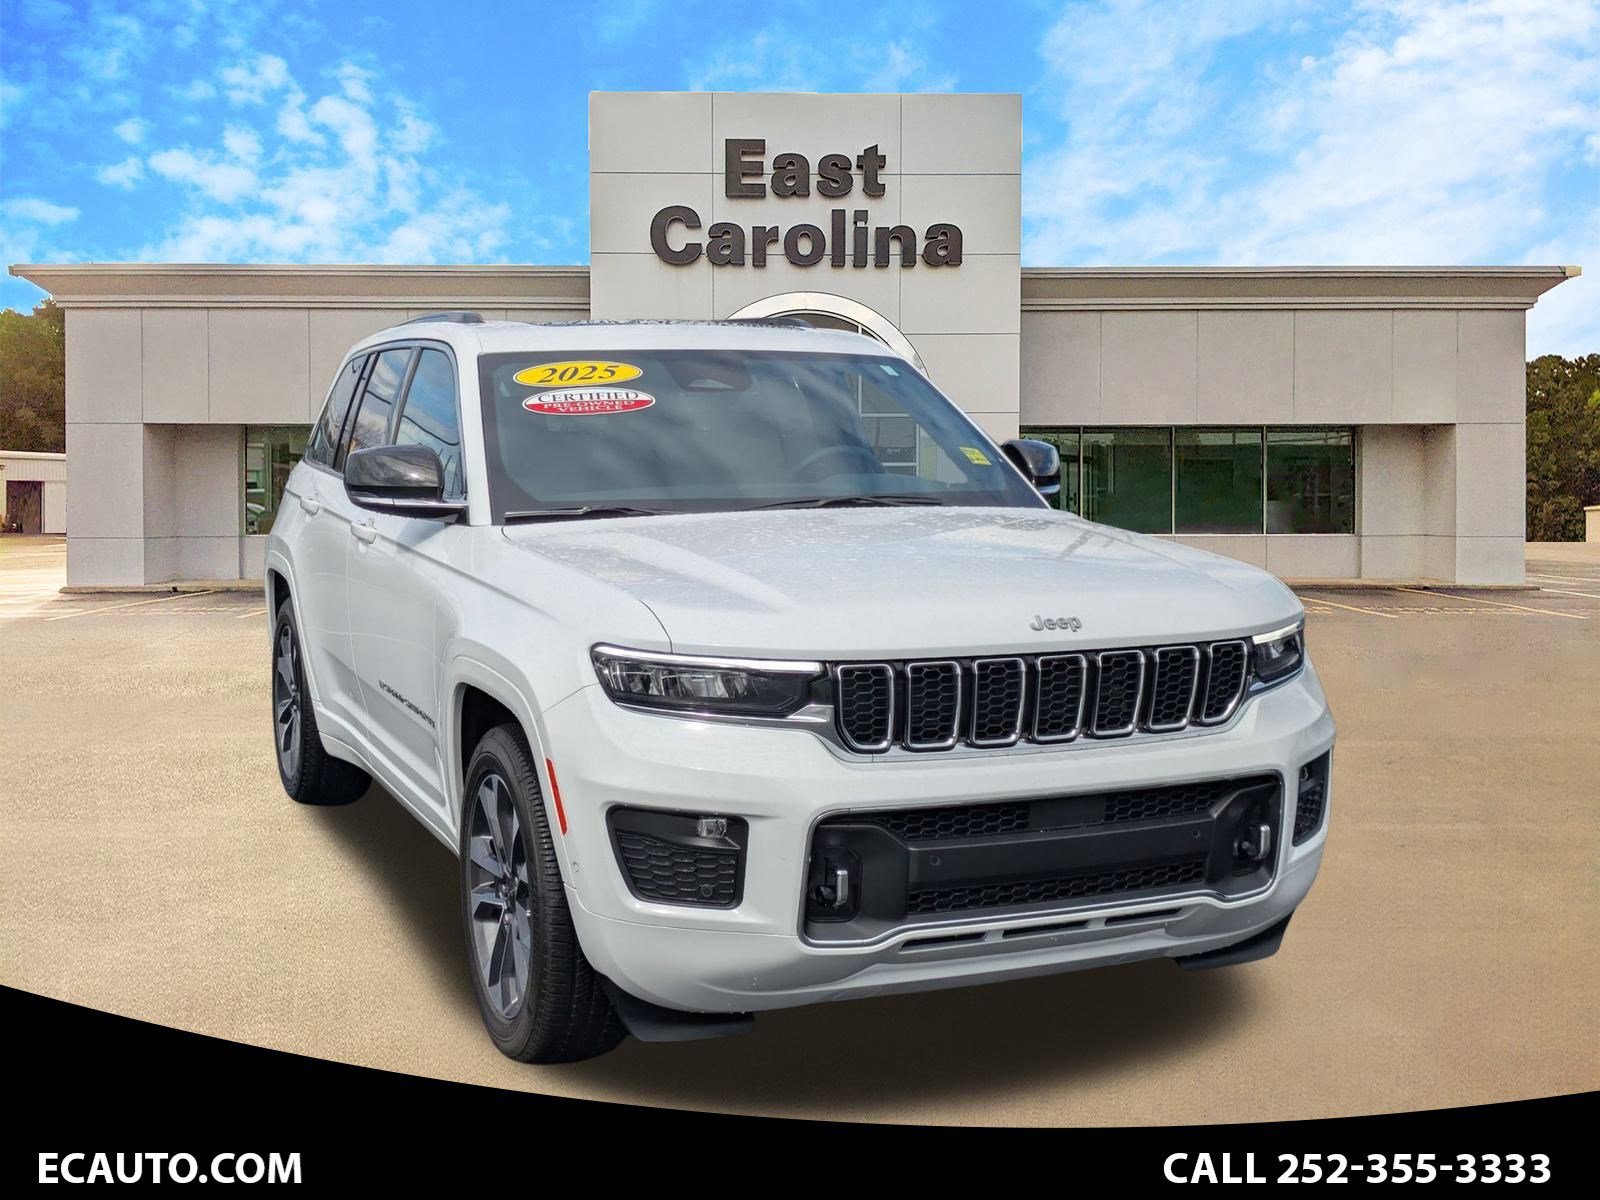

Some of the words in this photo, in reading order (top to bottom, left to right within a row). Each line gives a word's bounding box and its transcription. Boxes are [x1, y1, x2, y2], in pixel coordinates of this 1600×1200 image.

[725, 138, 887, 199] East
[650, 205, 964, 269] Carolina
[536, 365, 620, 384] 2025
[538, 391, 639, 403] CERTIFIED
[559, 405, 623, 413] VEHICLE
[1029, 614, 1082, 633] Jeep
